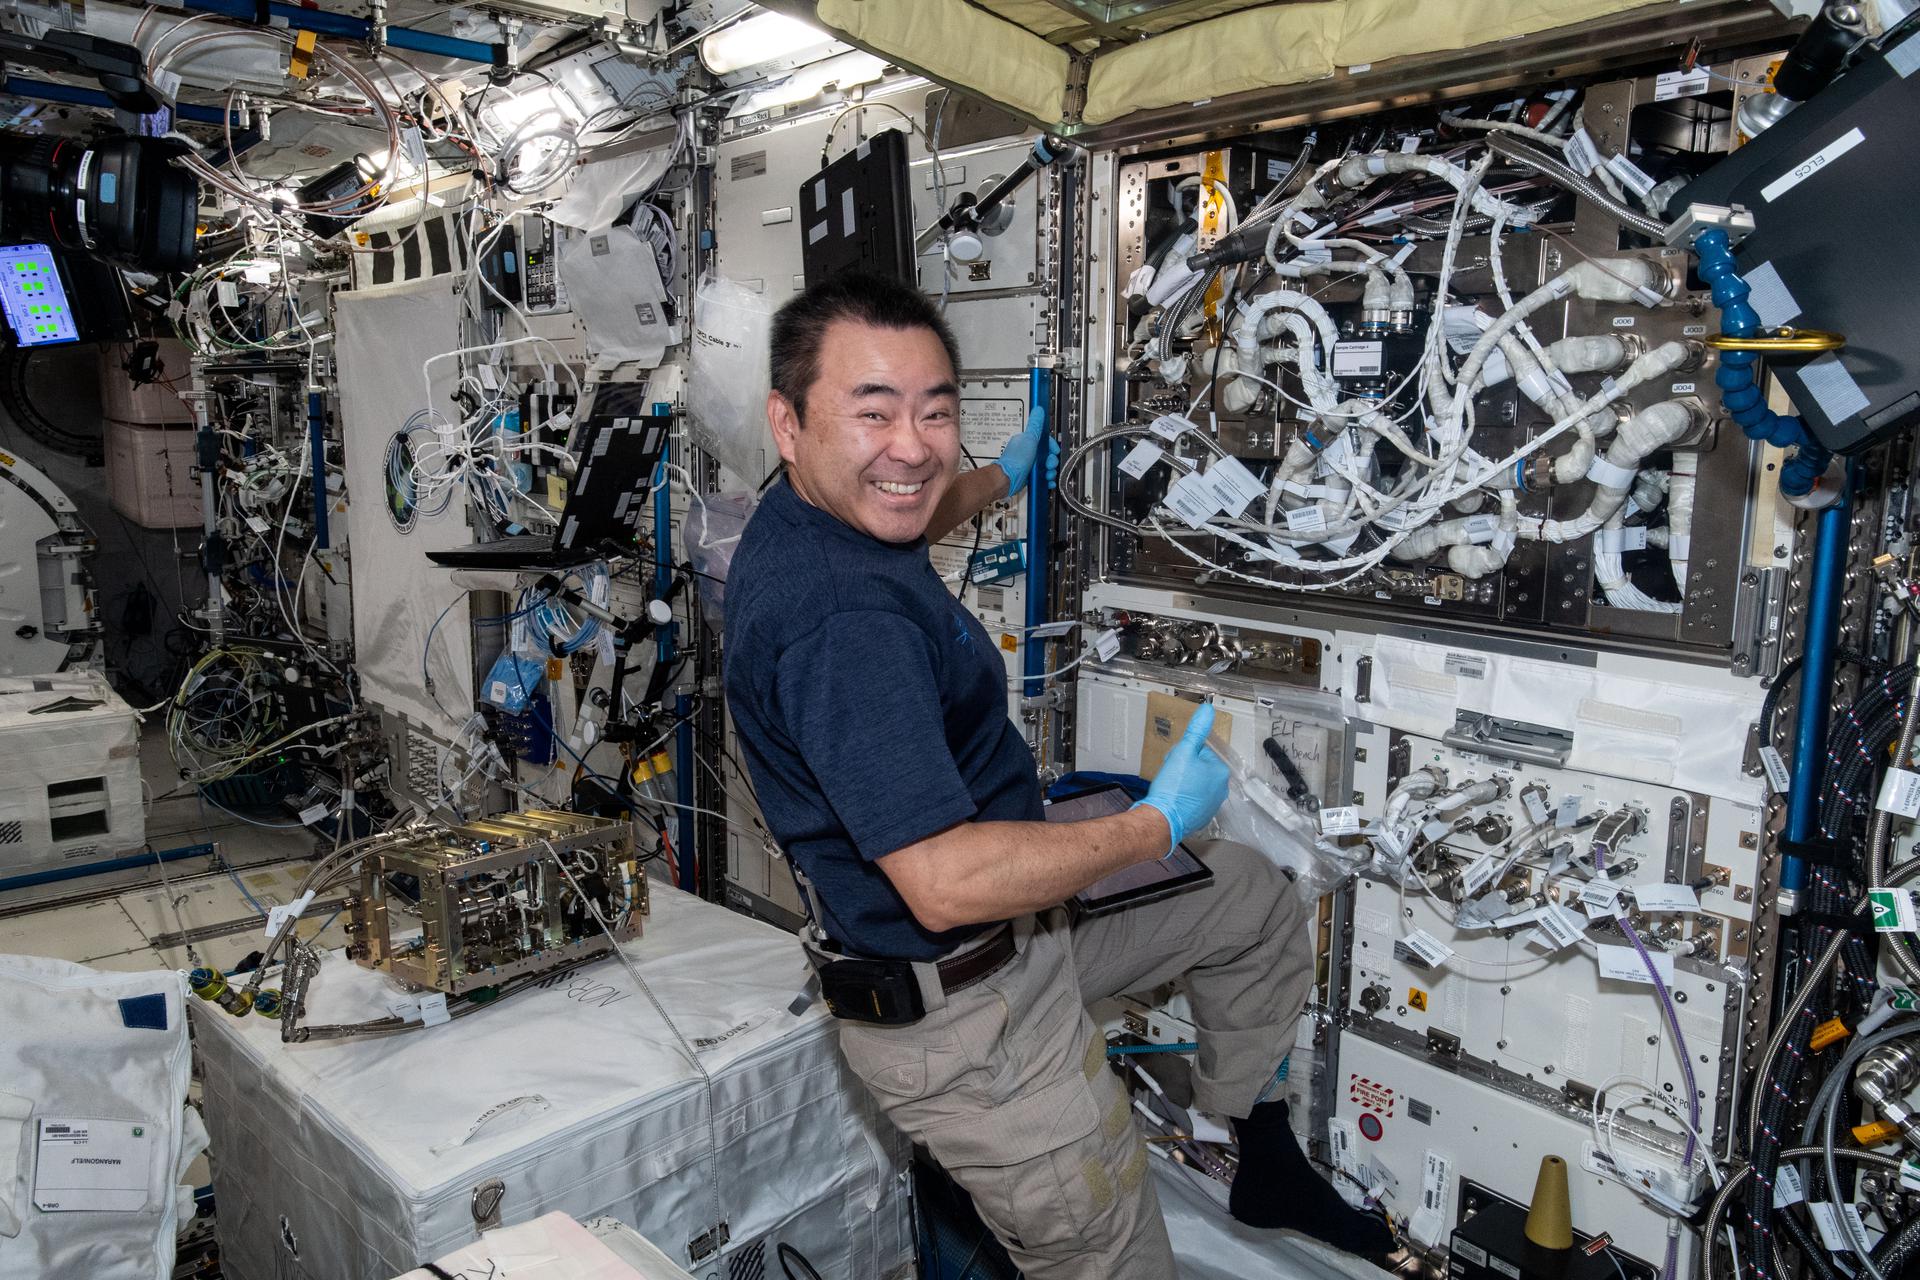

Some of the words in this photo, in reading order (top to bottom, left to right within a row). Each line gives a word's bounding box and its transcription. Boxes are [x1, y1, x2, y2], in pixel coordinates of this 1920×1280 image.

[1794, 154, 1825, 179] ELC5
[708, 335, 725, 347] Cable
[1271, 721, 1302, 738] ELF
[1291, 743, 1320, 762] bench
[726, 1021, 750, 1037] ONLY
[1356, 1087, 1370, 1098] FIRE
[1370, 1092, 1388, 1105] PORT
[71, 1157, 122, 1166] MARANGONI/ELF
